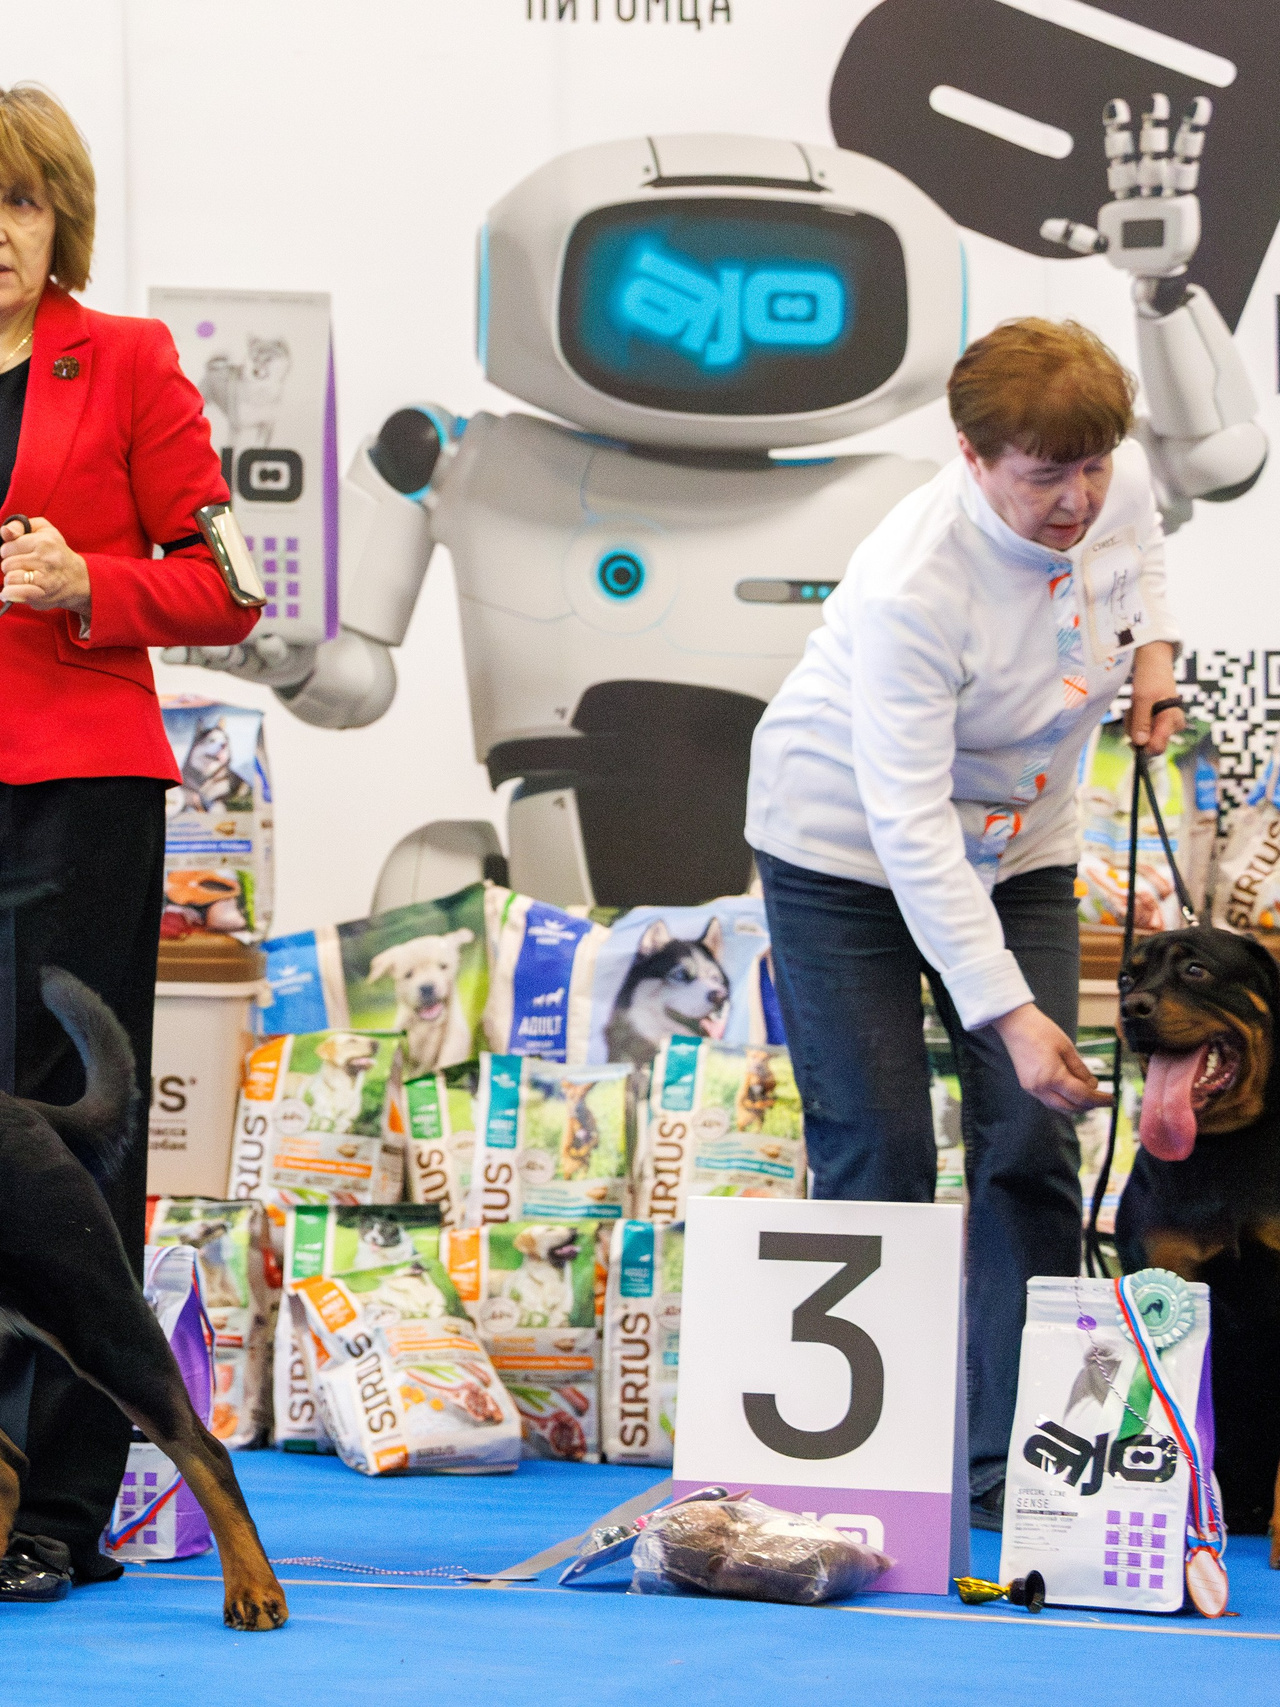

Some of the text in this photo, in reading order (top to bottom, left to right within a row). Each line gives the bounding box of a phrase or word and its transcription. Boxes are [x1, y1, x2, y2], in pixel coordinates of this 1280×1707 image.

[518, 1015, 563, 1036] ADULT
[621, 1313, 651, 1447] SIRIUS
[742, 1231, 885, 1460] 3
[1016, 1497, 1050, 1509] SENSE
